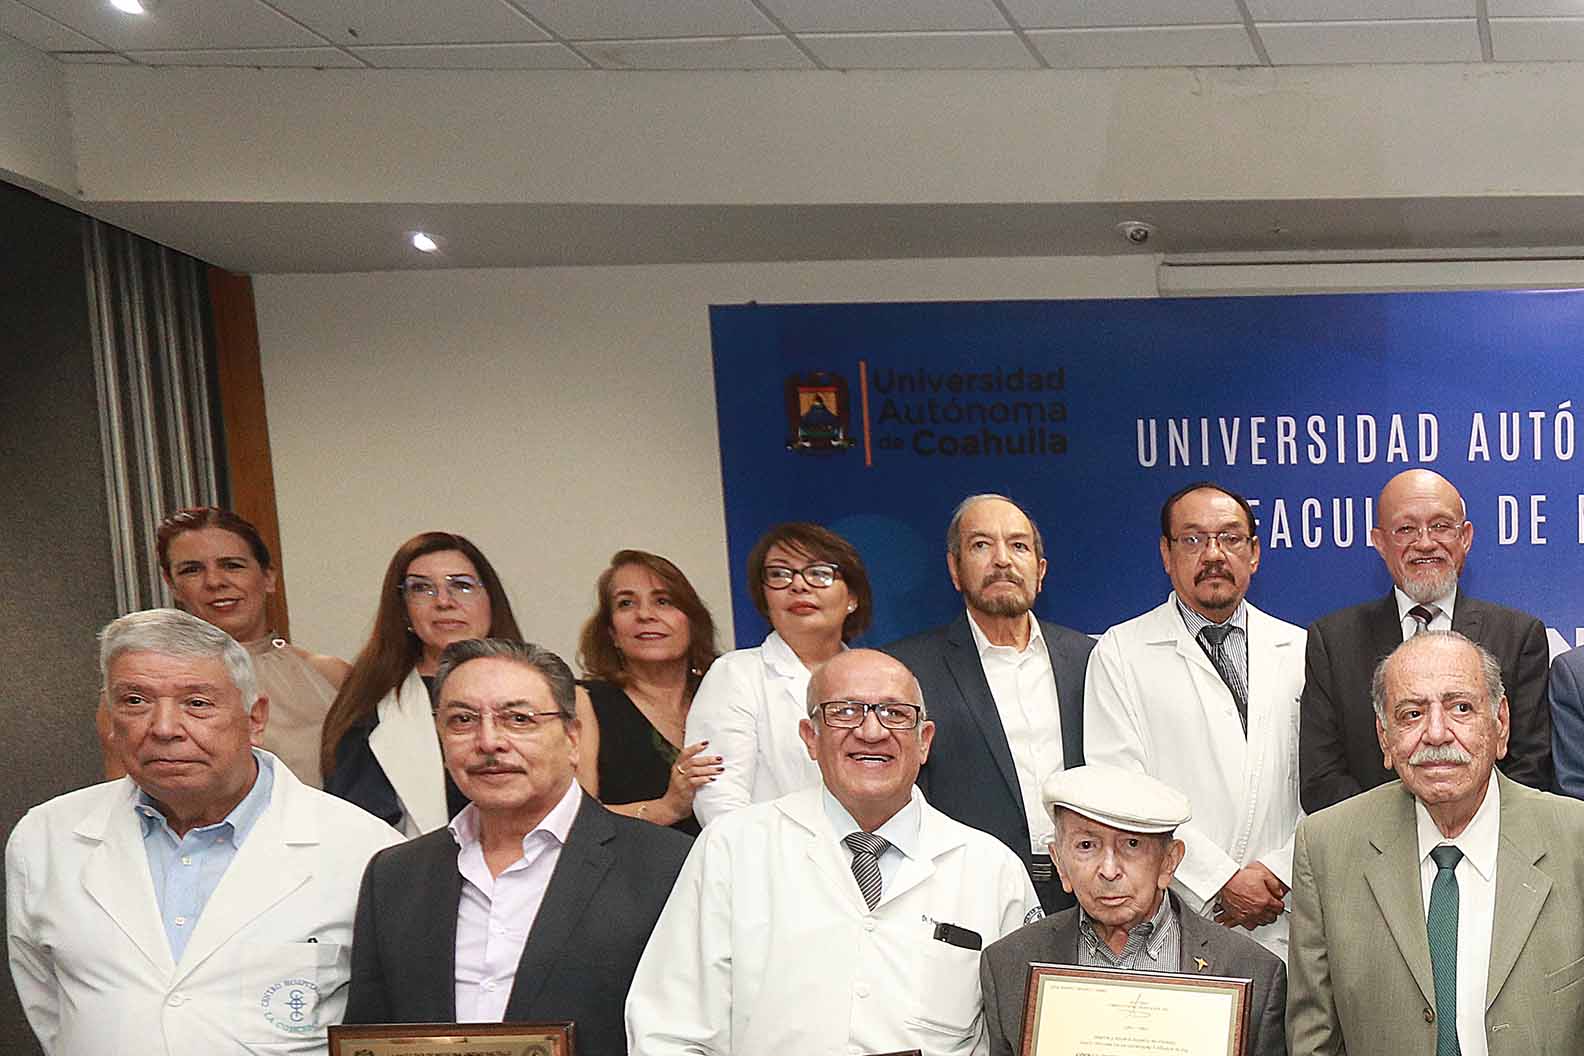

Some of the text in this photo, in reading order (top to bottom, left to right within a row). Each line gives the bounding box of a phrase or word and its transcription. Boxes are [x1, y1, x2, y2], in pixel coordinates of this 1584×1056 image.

[872, 367, 1066, 392] Universidad
[878, 398, 1068, 425] Autónoma
[880, 428, 1068, 457] de Coahuila
[1136, 413, 1439, 468] UNIVERSIDAD
[1498, 494, 1547, 546] DE
